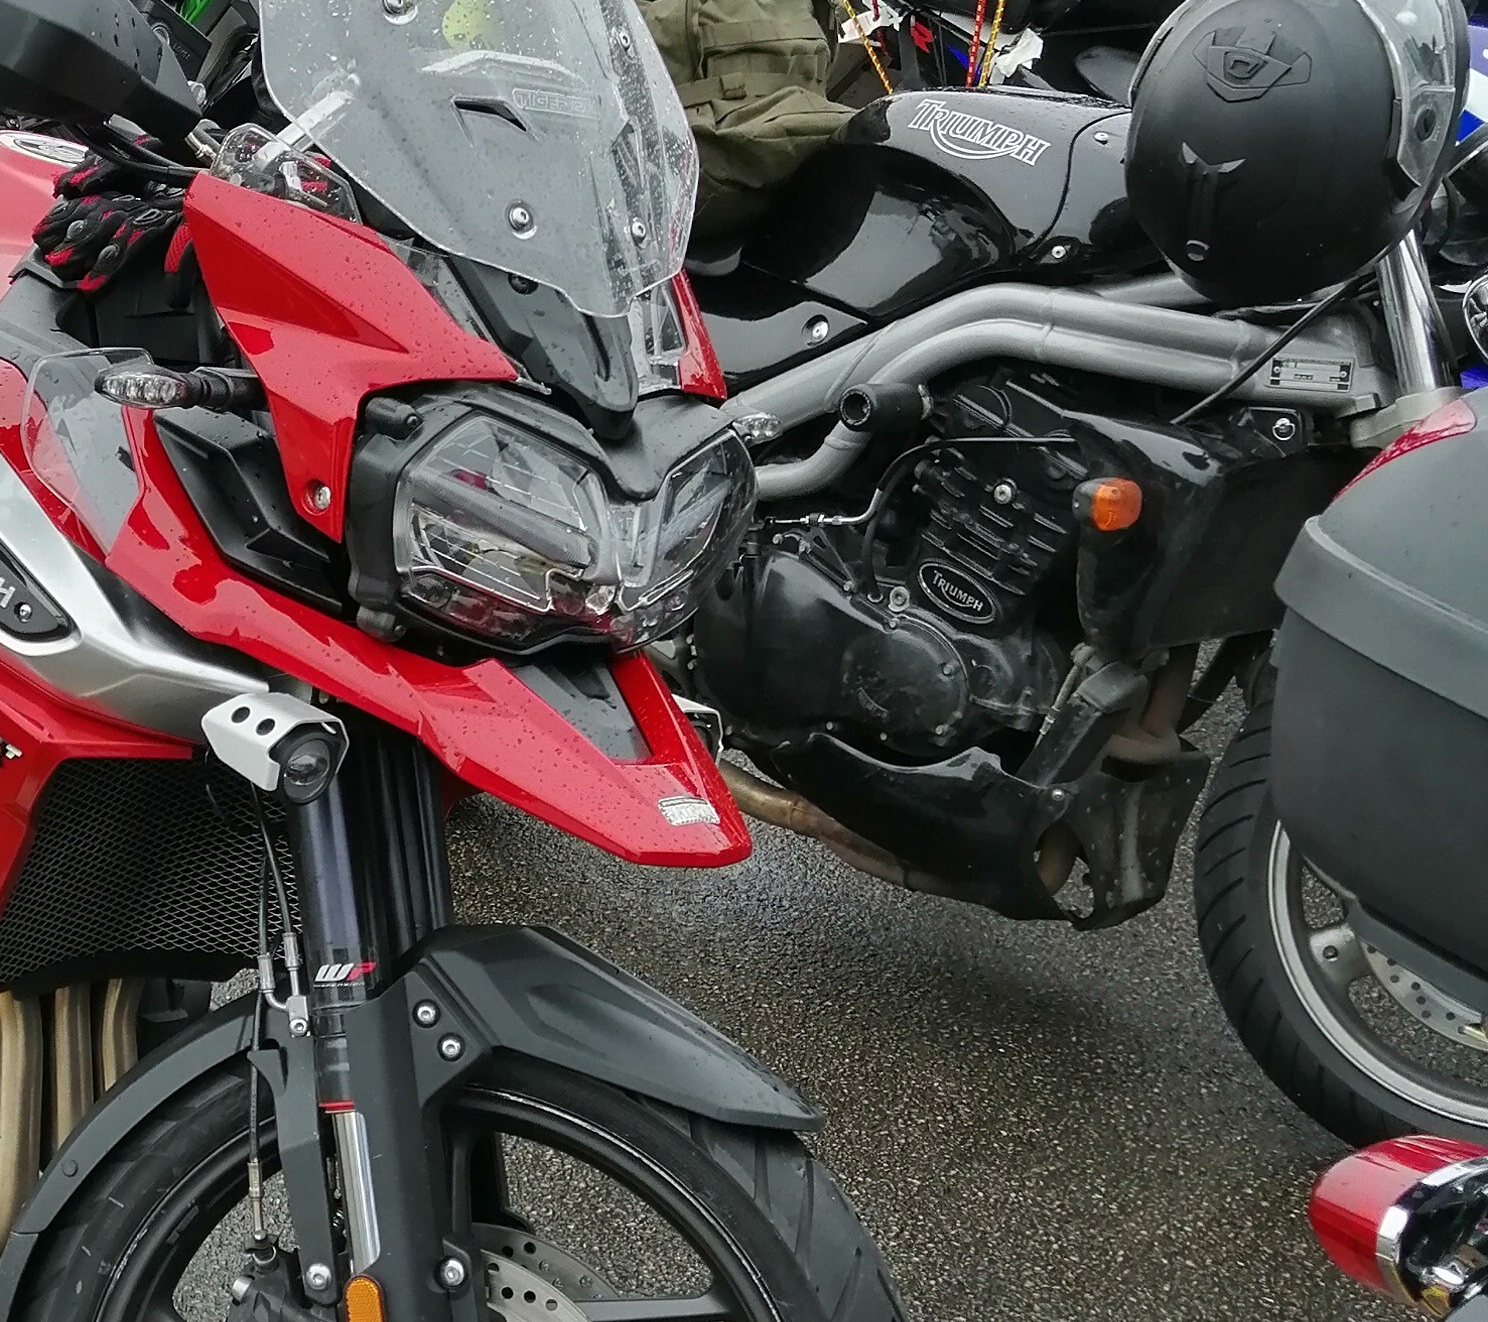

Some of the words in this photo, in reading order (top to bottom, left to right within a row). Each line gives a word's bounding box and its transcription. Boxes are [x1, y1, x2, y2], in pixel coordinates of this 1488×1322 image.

[907, 98, 1052, 166] TRIUMPH
[932, 569, 984, 612] TRIUMPH
[314, 961, 377, 982] WP
